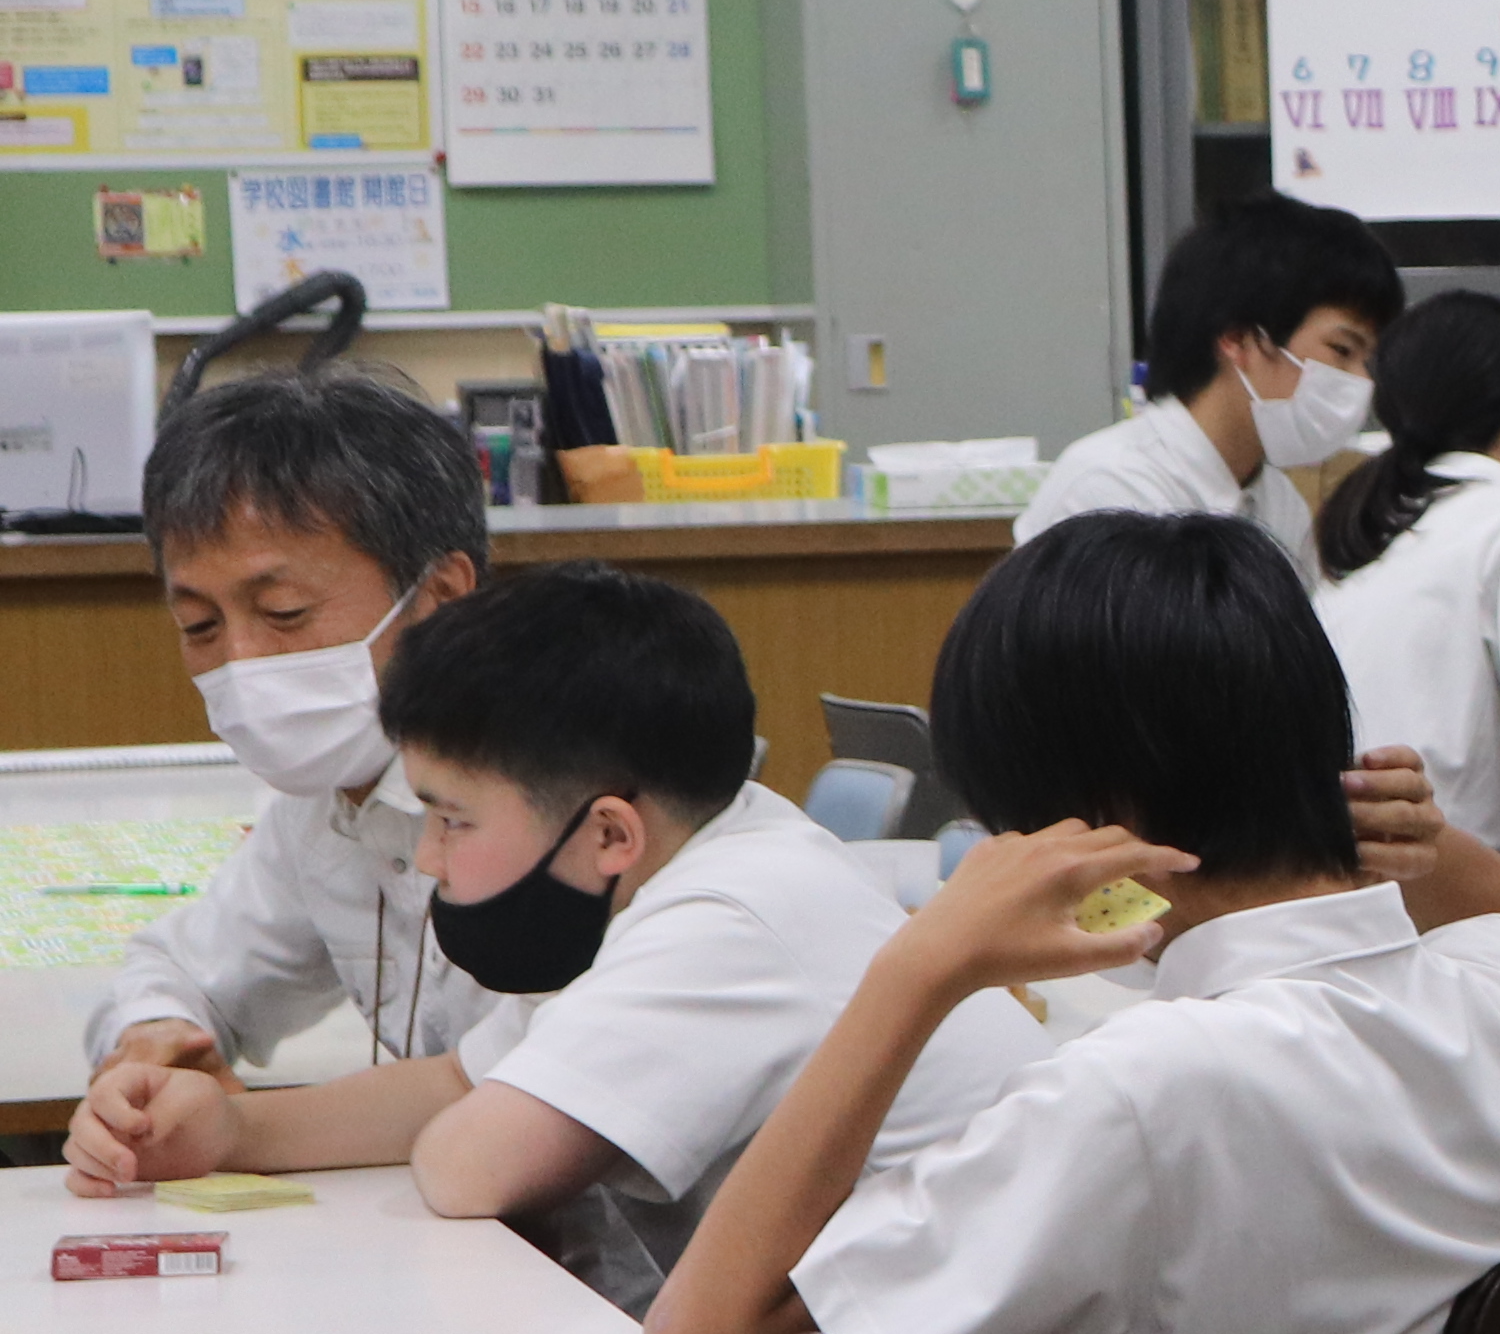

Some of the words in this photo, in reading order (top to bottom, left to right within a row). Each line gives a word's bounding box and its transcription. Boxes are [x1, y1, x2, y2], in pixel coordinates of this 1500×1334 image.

[461, 43, 483, 59] 22
[496, 43, 518, 59] 23
[530, 42, 552, 58] 24
[564, 42, 586, 58] 25
[600, 42, 621, 58] 26
[634, 42, 655, 58] 27
[668, 42, 690, 58] 28
[1292, 55, 1313, 81] 6
[1347, 53, 1370, 81] 7
[1407, 49, 1435, 82] 8
[1476, 46, 1499, 77] 9
[463, 87, 485, 103] 29
[498, 87, 519, 102] 30
[533, 87, 554, 102] 31
